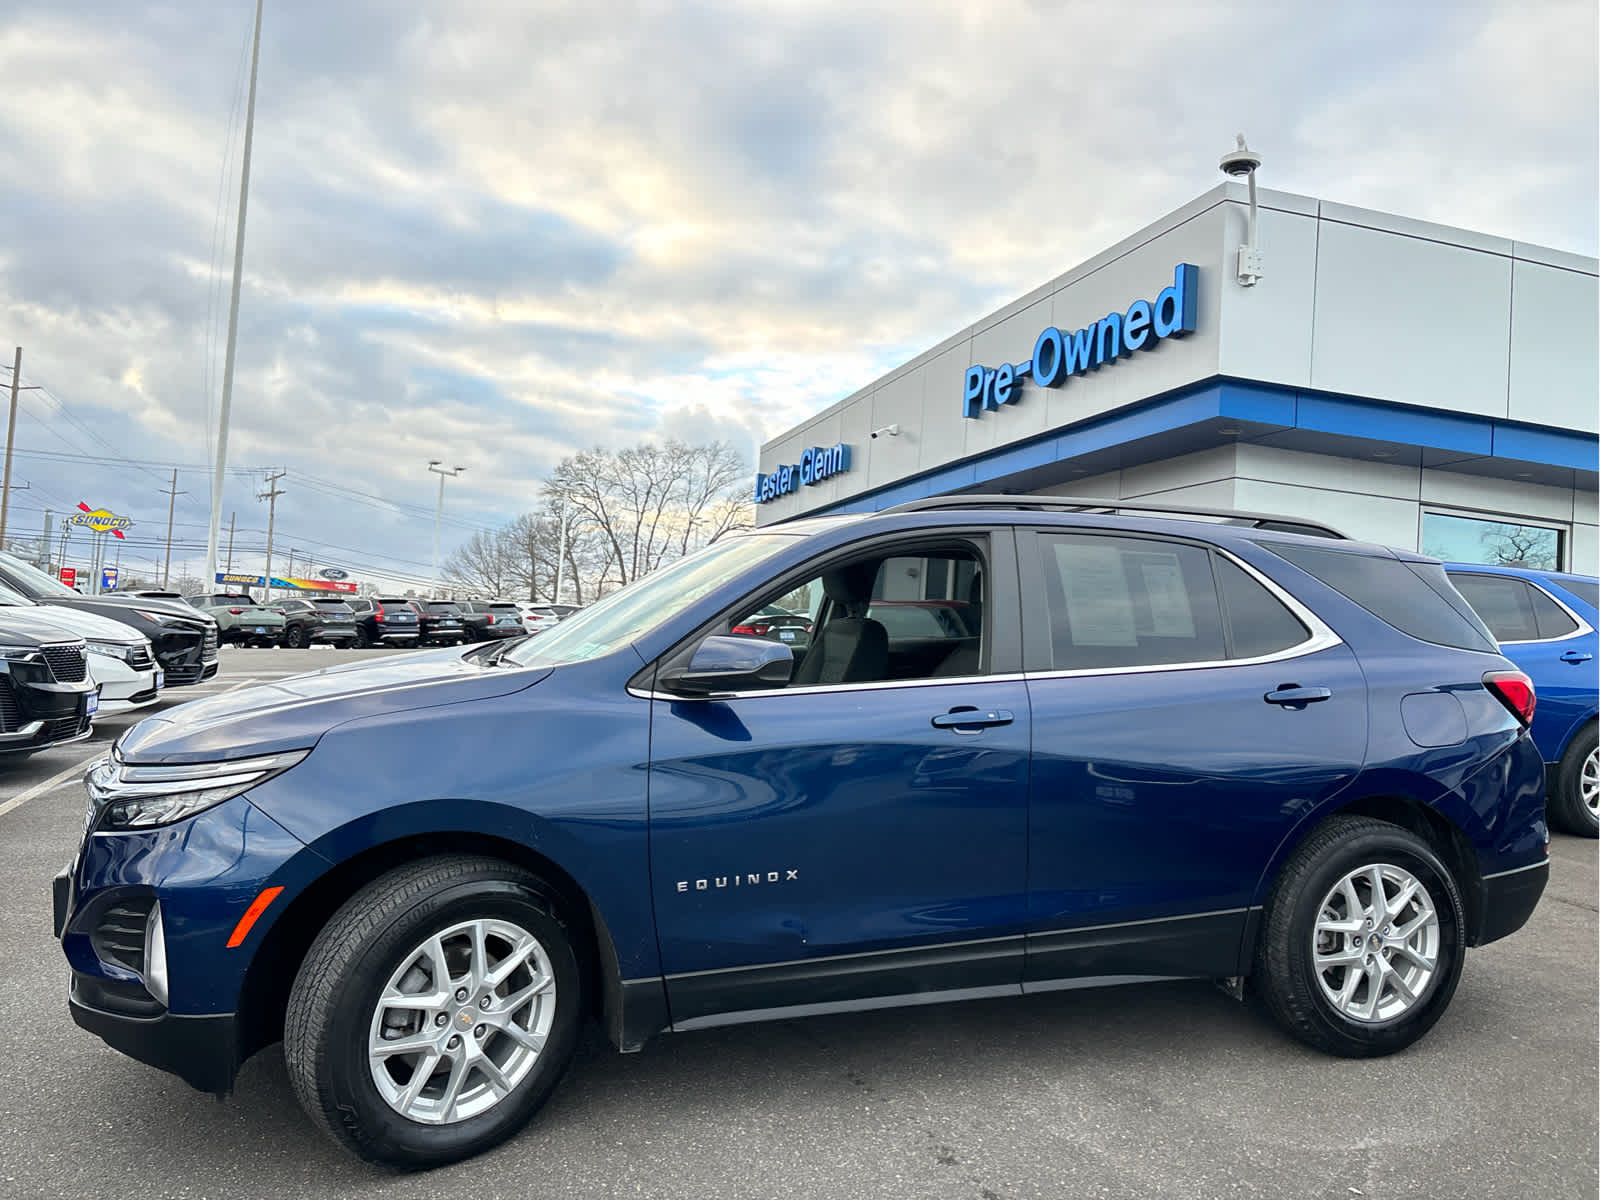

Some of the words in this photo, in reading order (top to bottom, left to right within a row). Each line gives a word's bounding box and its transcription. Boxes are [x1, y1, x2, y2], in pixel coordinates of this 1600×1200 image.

[963, 263, 1195, 418] Pre-Owned
[754, 464, 799, 503] Lester
[800, 443, 849, 486] Glenn
[76, 514, 128, 527] SUNOCO
[222, 574, 259, 584] SUNOCO
[677, 869, 798, 892] EQUINOX
